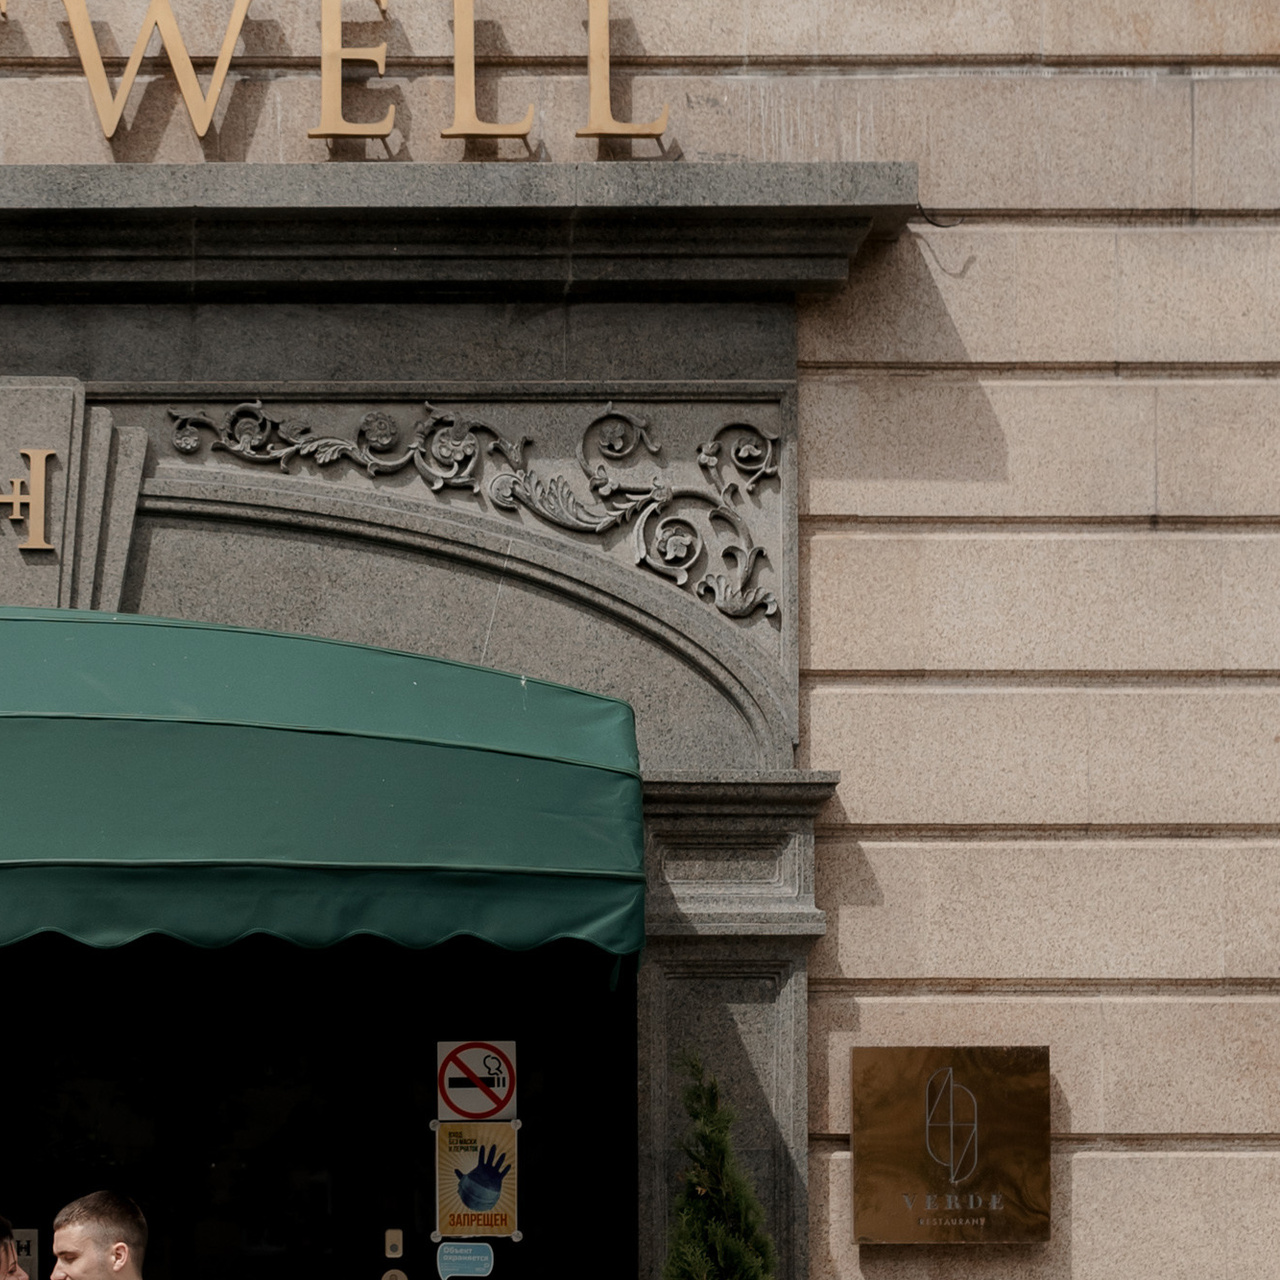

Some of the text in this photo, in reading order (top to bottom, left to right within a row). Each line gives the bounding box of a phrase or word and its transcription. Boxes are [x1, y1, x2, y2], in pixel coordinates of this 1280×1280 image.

[902, 1193, 1004, 1211] VERDE
[449, 1213, 508, 1227] ЗАПРЕЩЕН
[443, 1246, 473, 1254] Объект
